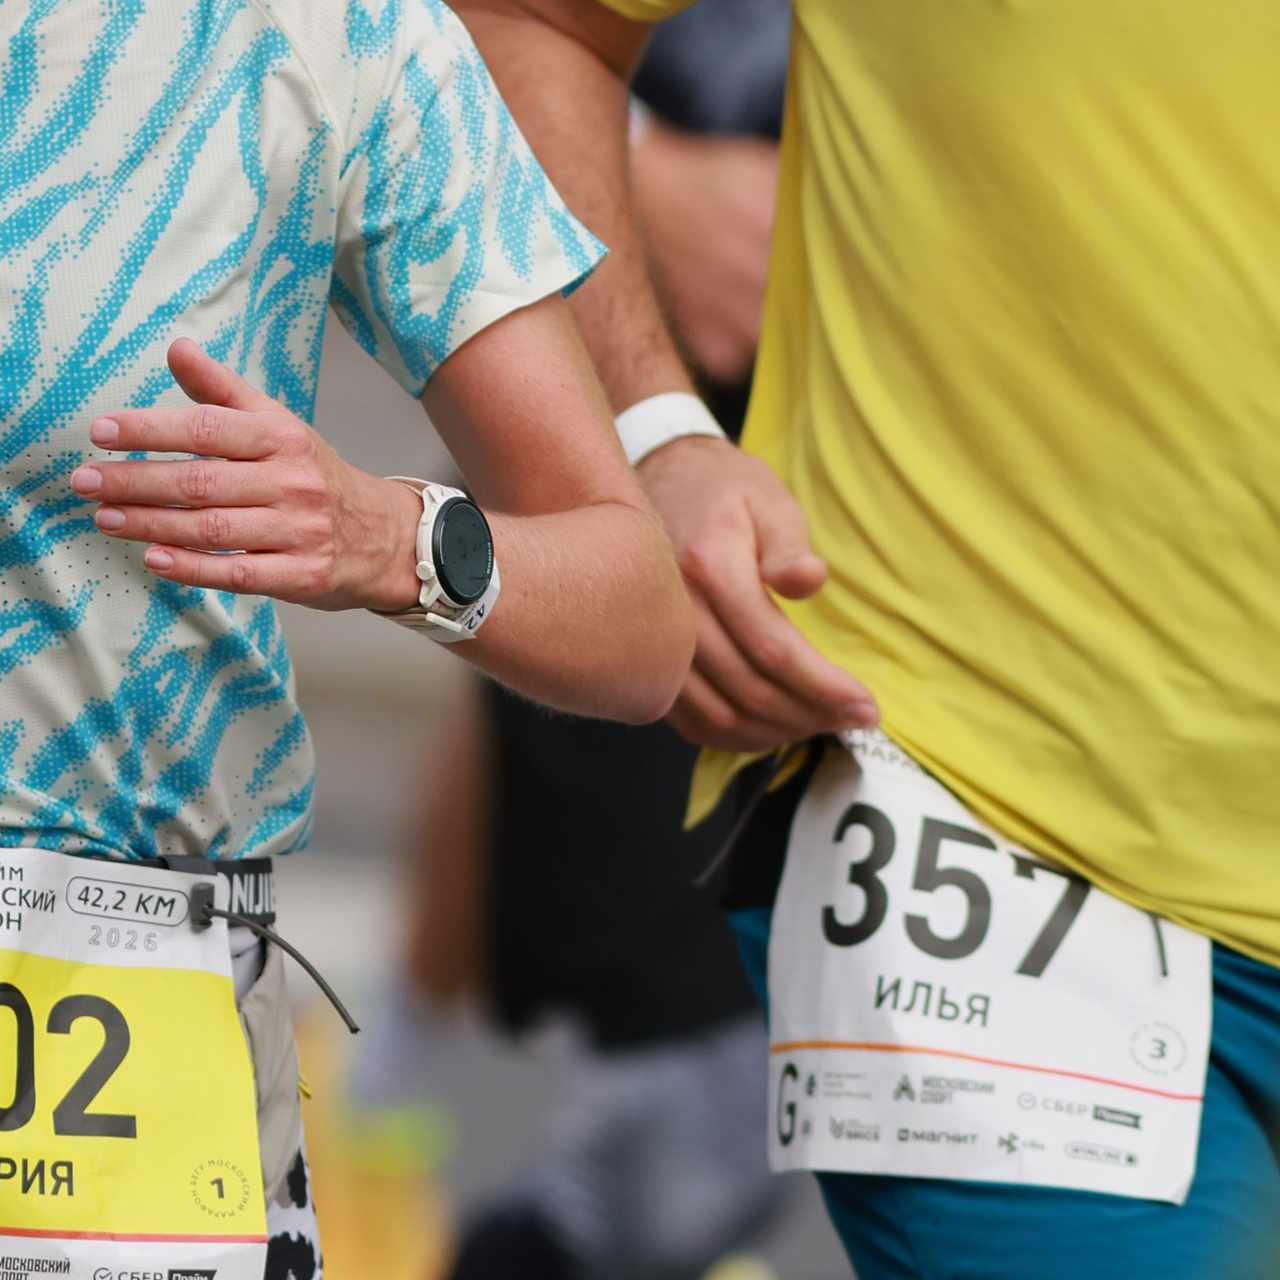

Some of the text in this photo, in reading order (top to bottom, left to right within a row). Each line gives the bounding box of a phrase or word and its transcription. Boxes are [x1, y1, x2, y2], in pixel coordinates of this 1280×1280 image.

[77, 885, 127, 911] 42,2
[821, 802, 1093, 979] 357
[88, 924, 158, 952] 2026
[873, 973, 992, 1027] ИЛЬЯ
[1149, 1037, 1166, 1059] 3
[777, 1062, 799, 1147] G
[210, 1177, 224, 1199] 1
